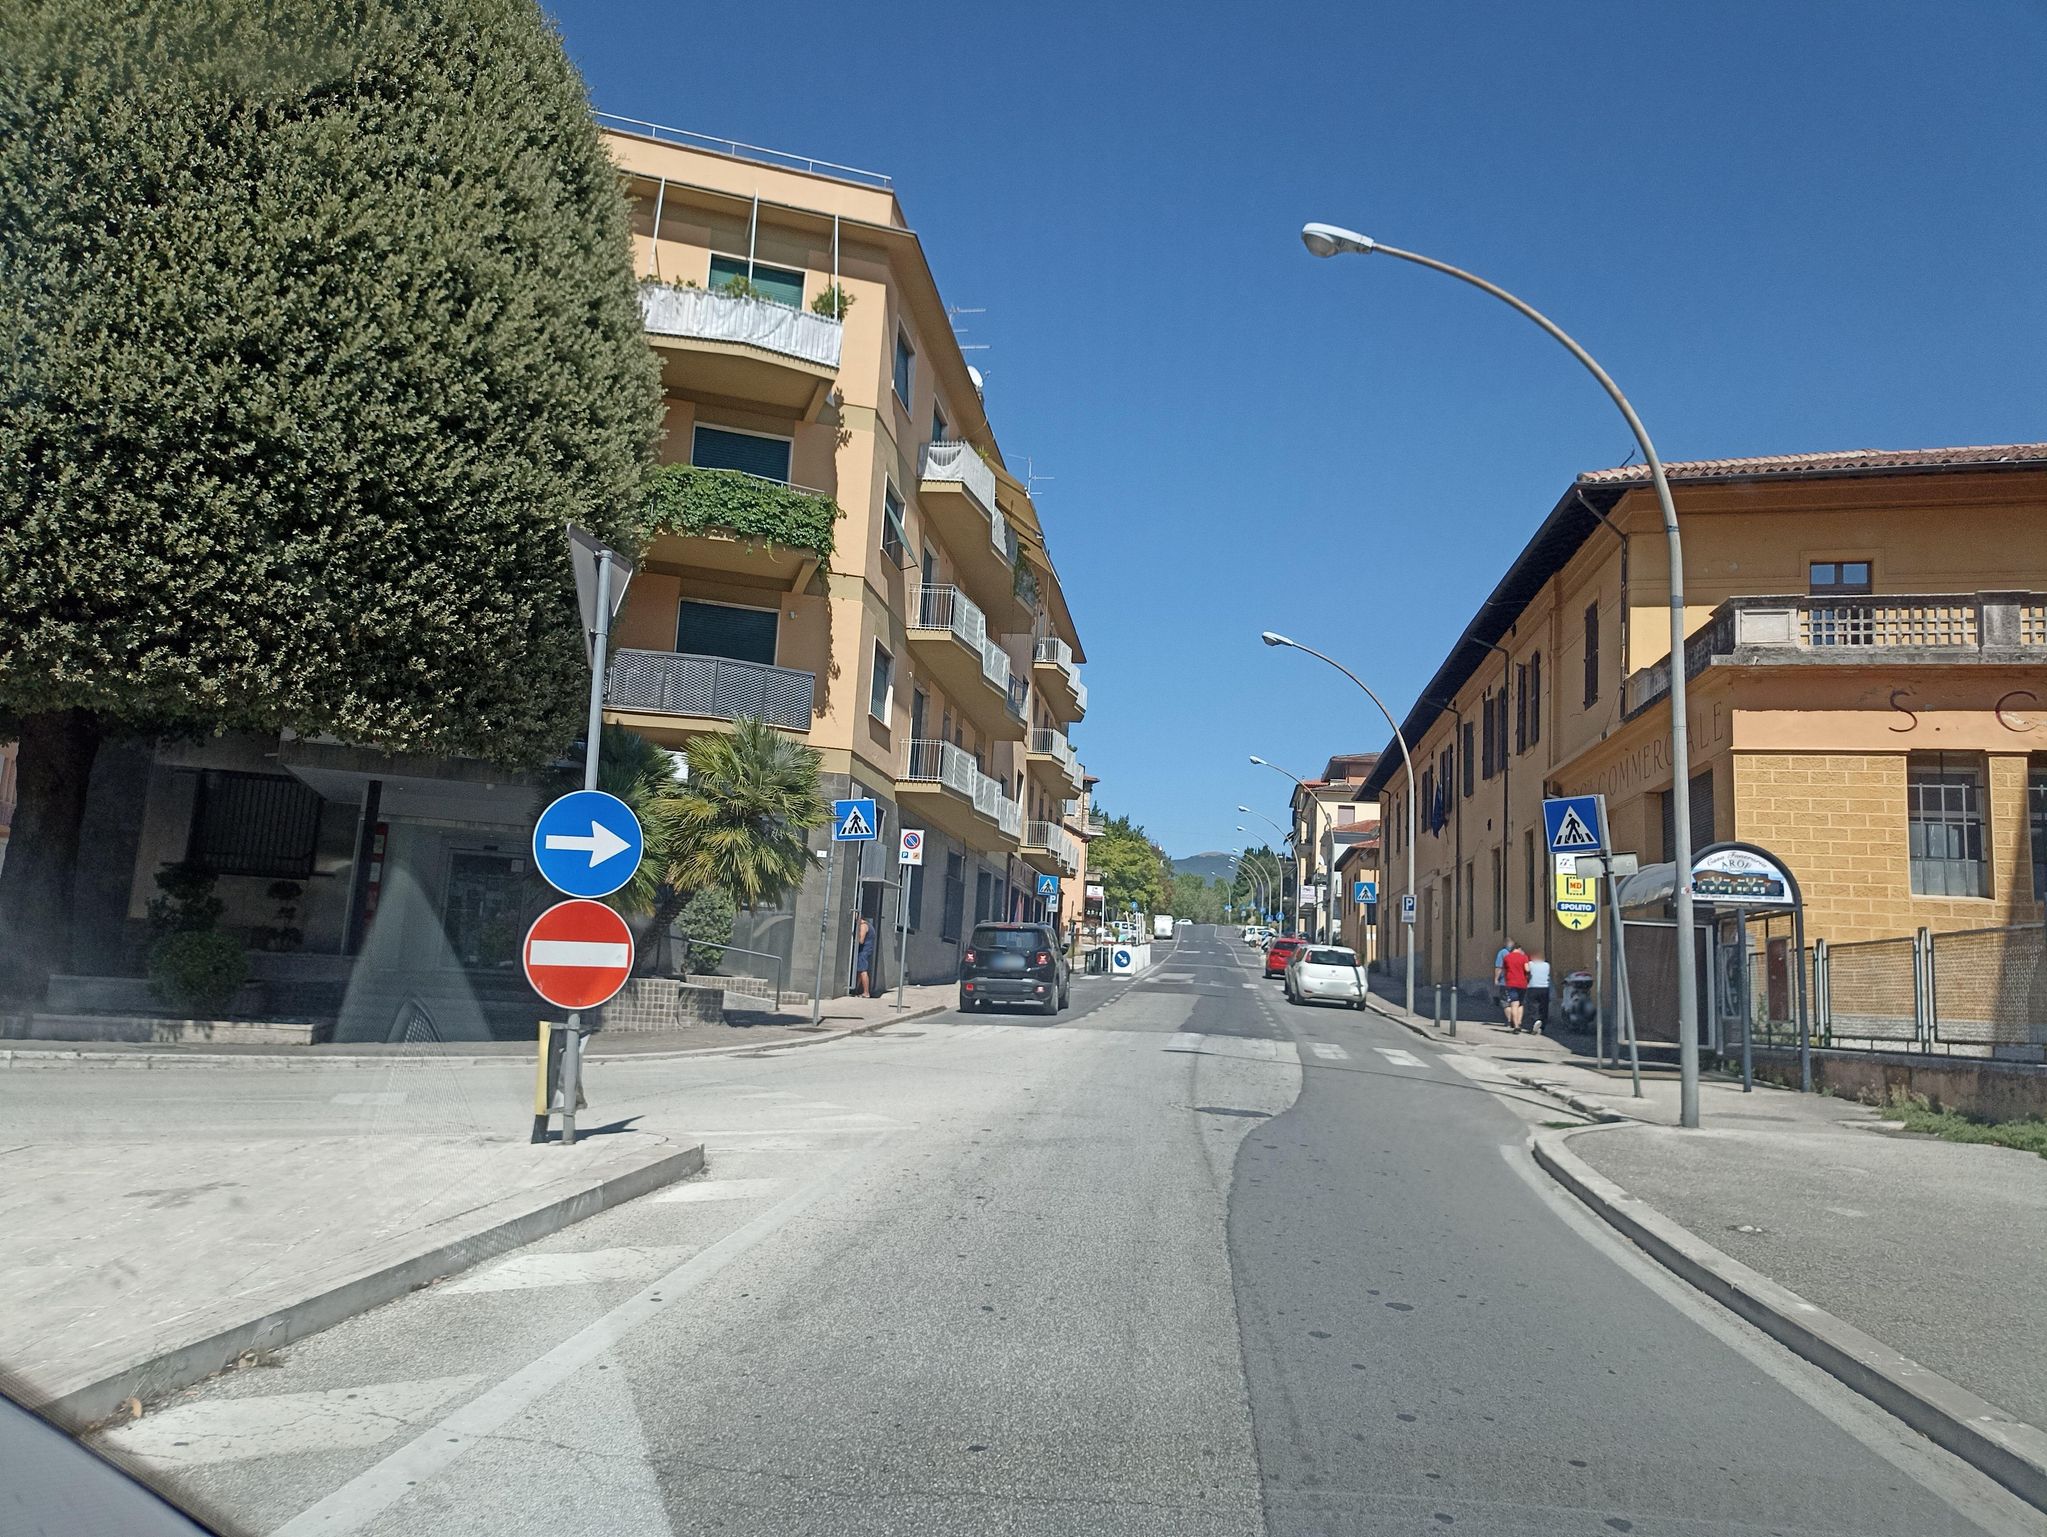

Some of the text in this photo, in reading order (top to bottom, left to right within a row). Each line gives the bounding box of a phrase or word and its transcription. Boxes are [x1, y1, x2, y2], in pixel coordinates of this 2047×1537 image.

[1597, 701, 1723, 797] COMMERCALE
[1405, 898, 1414, 910] P
[1560, 903, 1592, 911] SPOLETO
